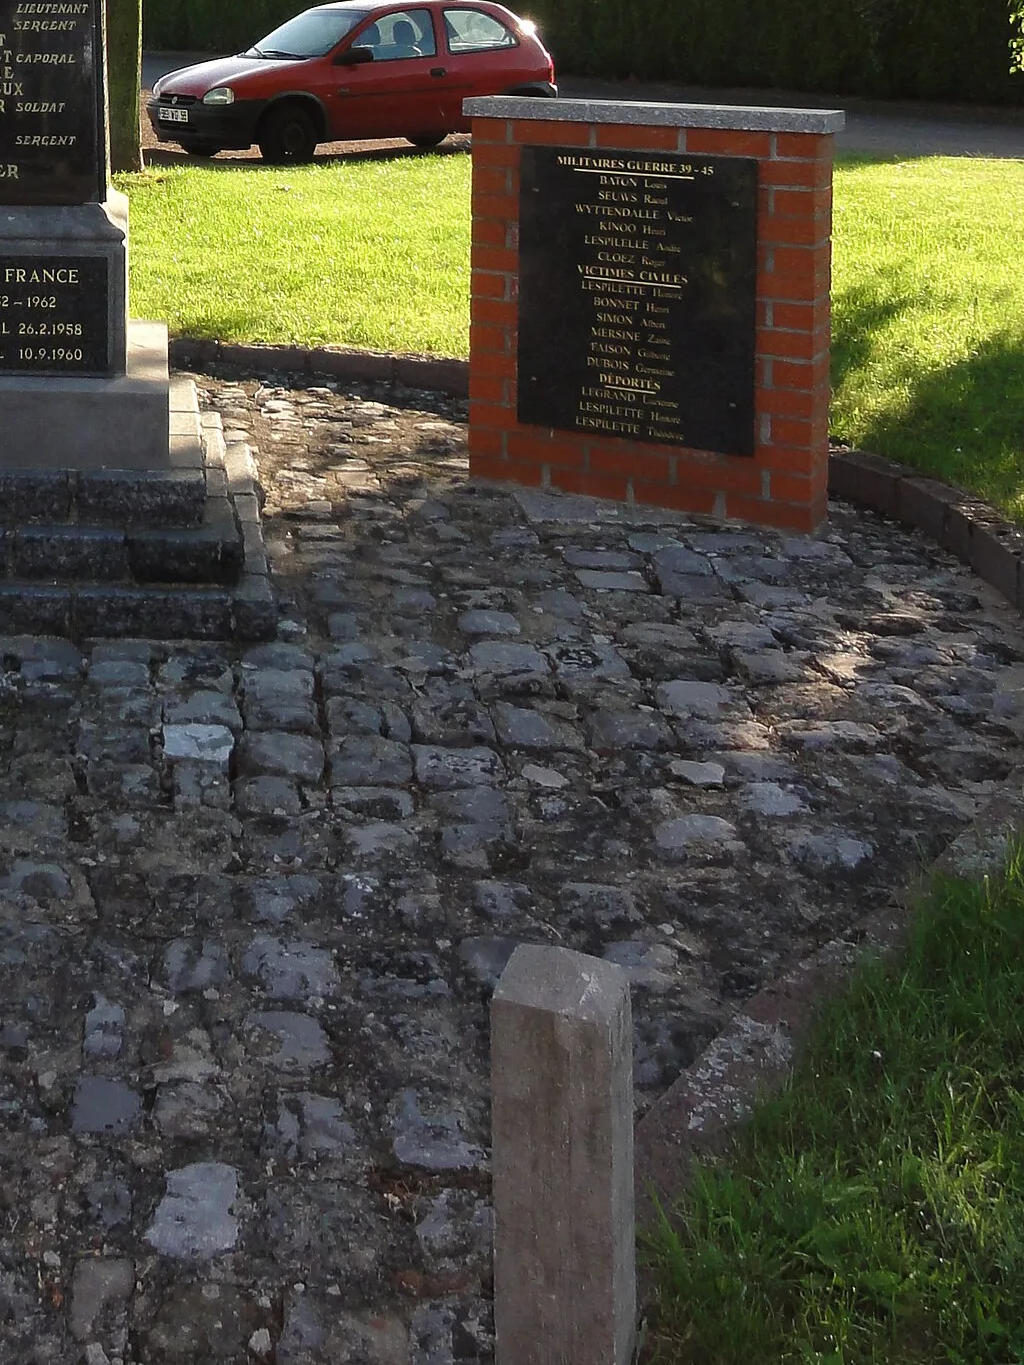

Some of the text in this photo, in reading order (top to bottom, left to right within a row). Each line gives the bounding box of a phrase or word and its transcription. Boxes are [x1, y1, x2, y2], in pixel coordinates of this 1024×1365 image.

[16, 3, 88, 14] LIEUTENANT
[13, 20, 76, 30] SERGENT
[16, 53, 75, 63] CAPORAL
[16, 102, 66, 112] SOLDAT
[15, 136, 76, 146] SERGENT
[557, 156, 624, 168] MILITAIRES
[627, 160, 676, 172] GUERRE
[679, 164, 692, 174] 39
[700, 166, 714, 175] 45
[600, 176, 637, 186] BATON
[5, 269, 79, 284] FRANCE
[577, 265, 688, 284] VICTIMES CIVILES
[594, 296, 640, 310] BONNET
[596, 313, 632, 324] SIMON
[18, 323, 83, 336] 26.2.1958
[591, 327, 640, 342] MERSINE
[18, 348, 83, 361] 10.9.1960
[587, 356, 629, 370] DUBOIS
